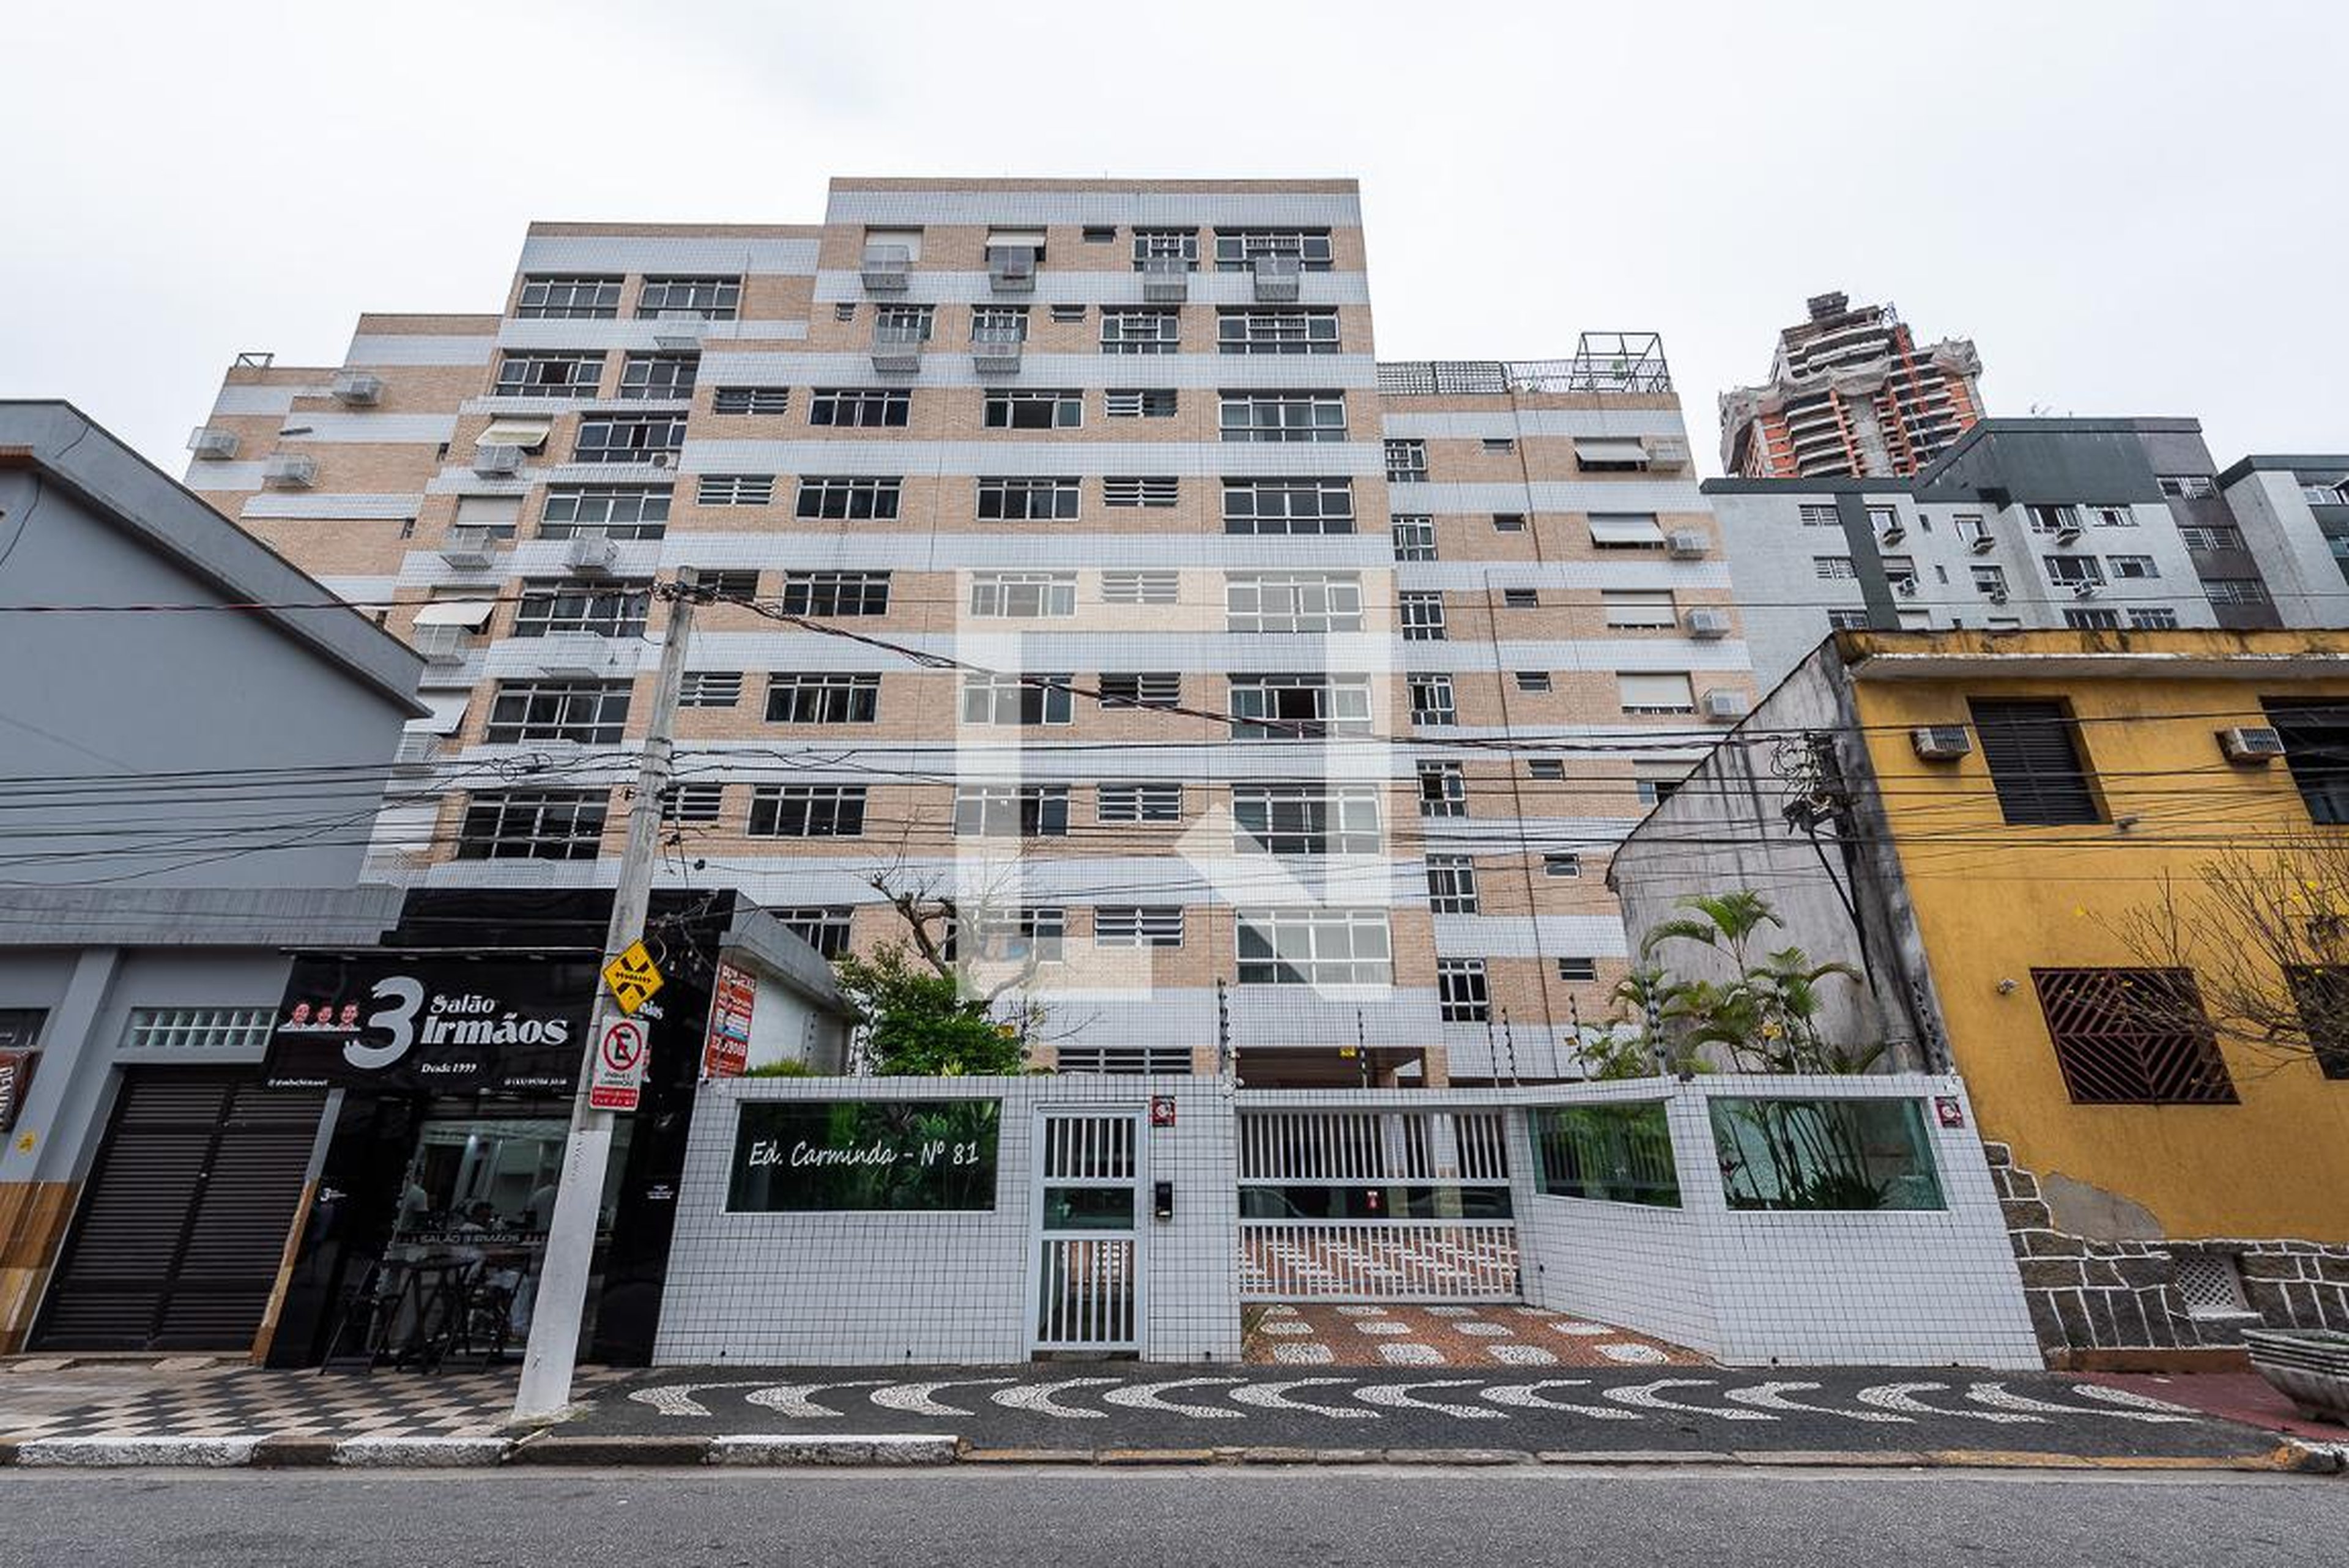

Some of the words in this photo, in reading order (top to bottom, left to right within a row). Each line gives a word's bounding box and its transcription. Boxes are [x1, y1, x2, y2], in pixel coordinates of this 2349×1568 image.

[430, 994, 495, 1014] Salão
[343, 975, 424, 1069] 3
[420, 1012, 569, 1045] Irmãos
[452, 1063, 477, 1073] 1999
[749, 1140, 783, 1167] Ed.
[791, 1139, 898, 1167] Carminda
[952, 1139, 979, 1165] 81
